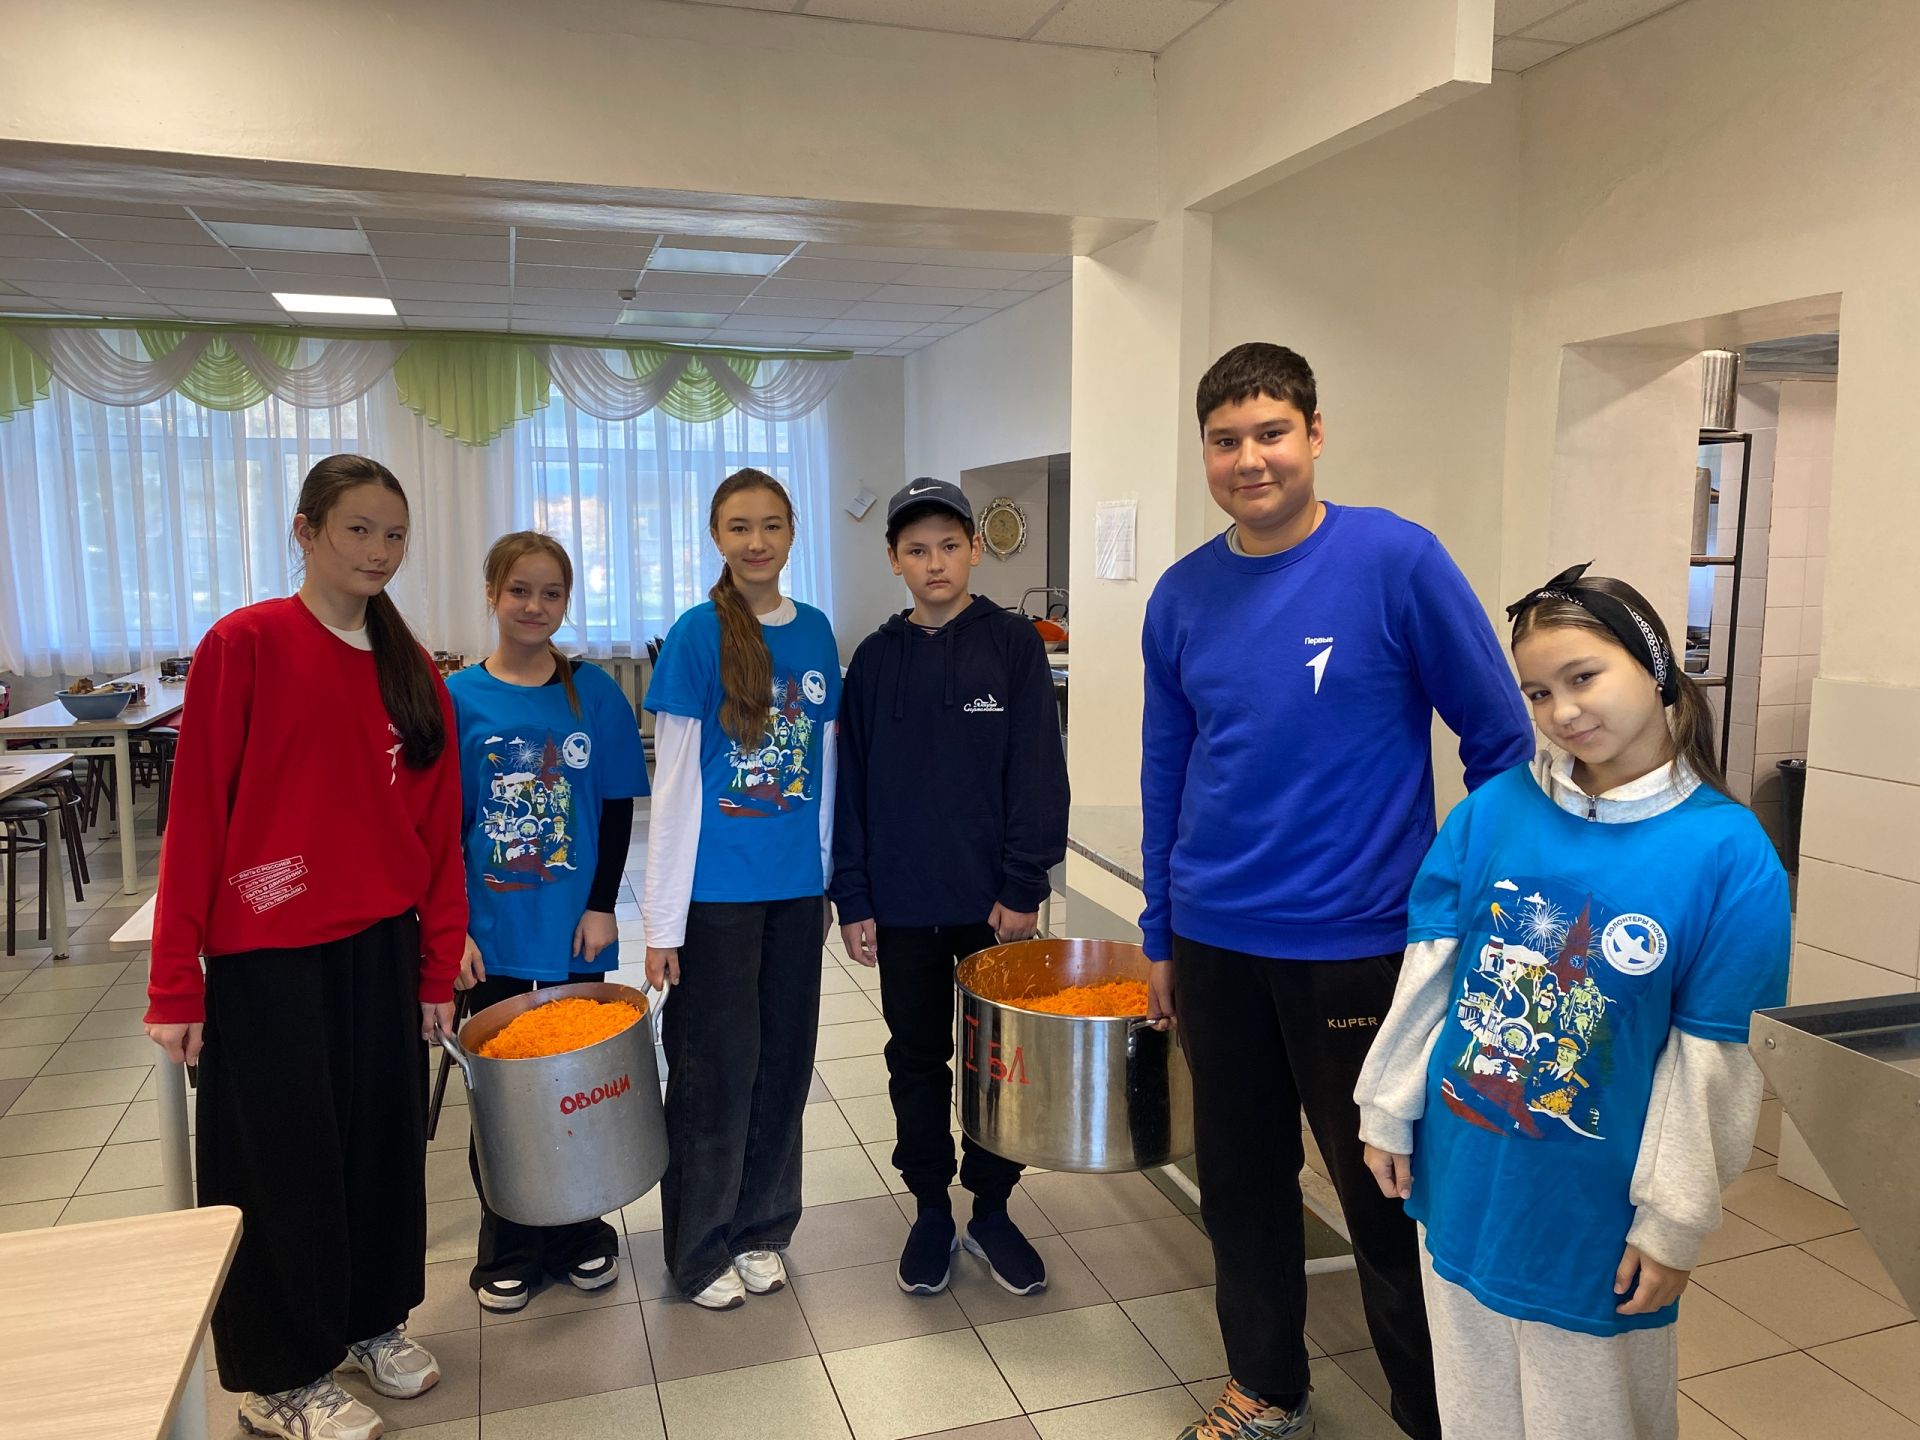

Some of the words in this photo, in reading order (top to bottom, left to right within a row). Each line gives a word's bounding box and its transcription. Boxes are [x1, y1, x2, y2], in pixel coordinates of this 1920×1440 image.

[1304, 636, 1334, 646] Первые
[1606, 915, 1649, 937] ВОЛОНТЕРЫ
[1649, 923, 1665, 954] ПОБЕДЫ
[1327, 1016, 1378, 1028] KUPER
[560, 1073, 631, 1115] ОВОЩИ
